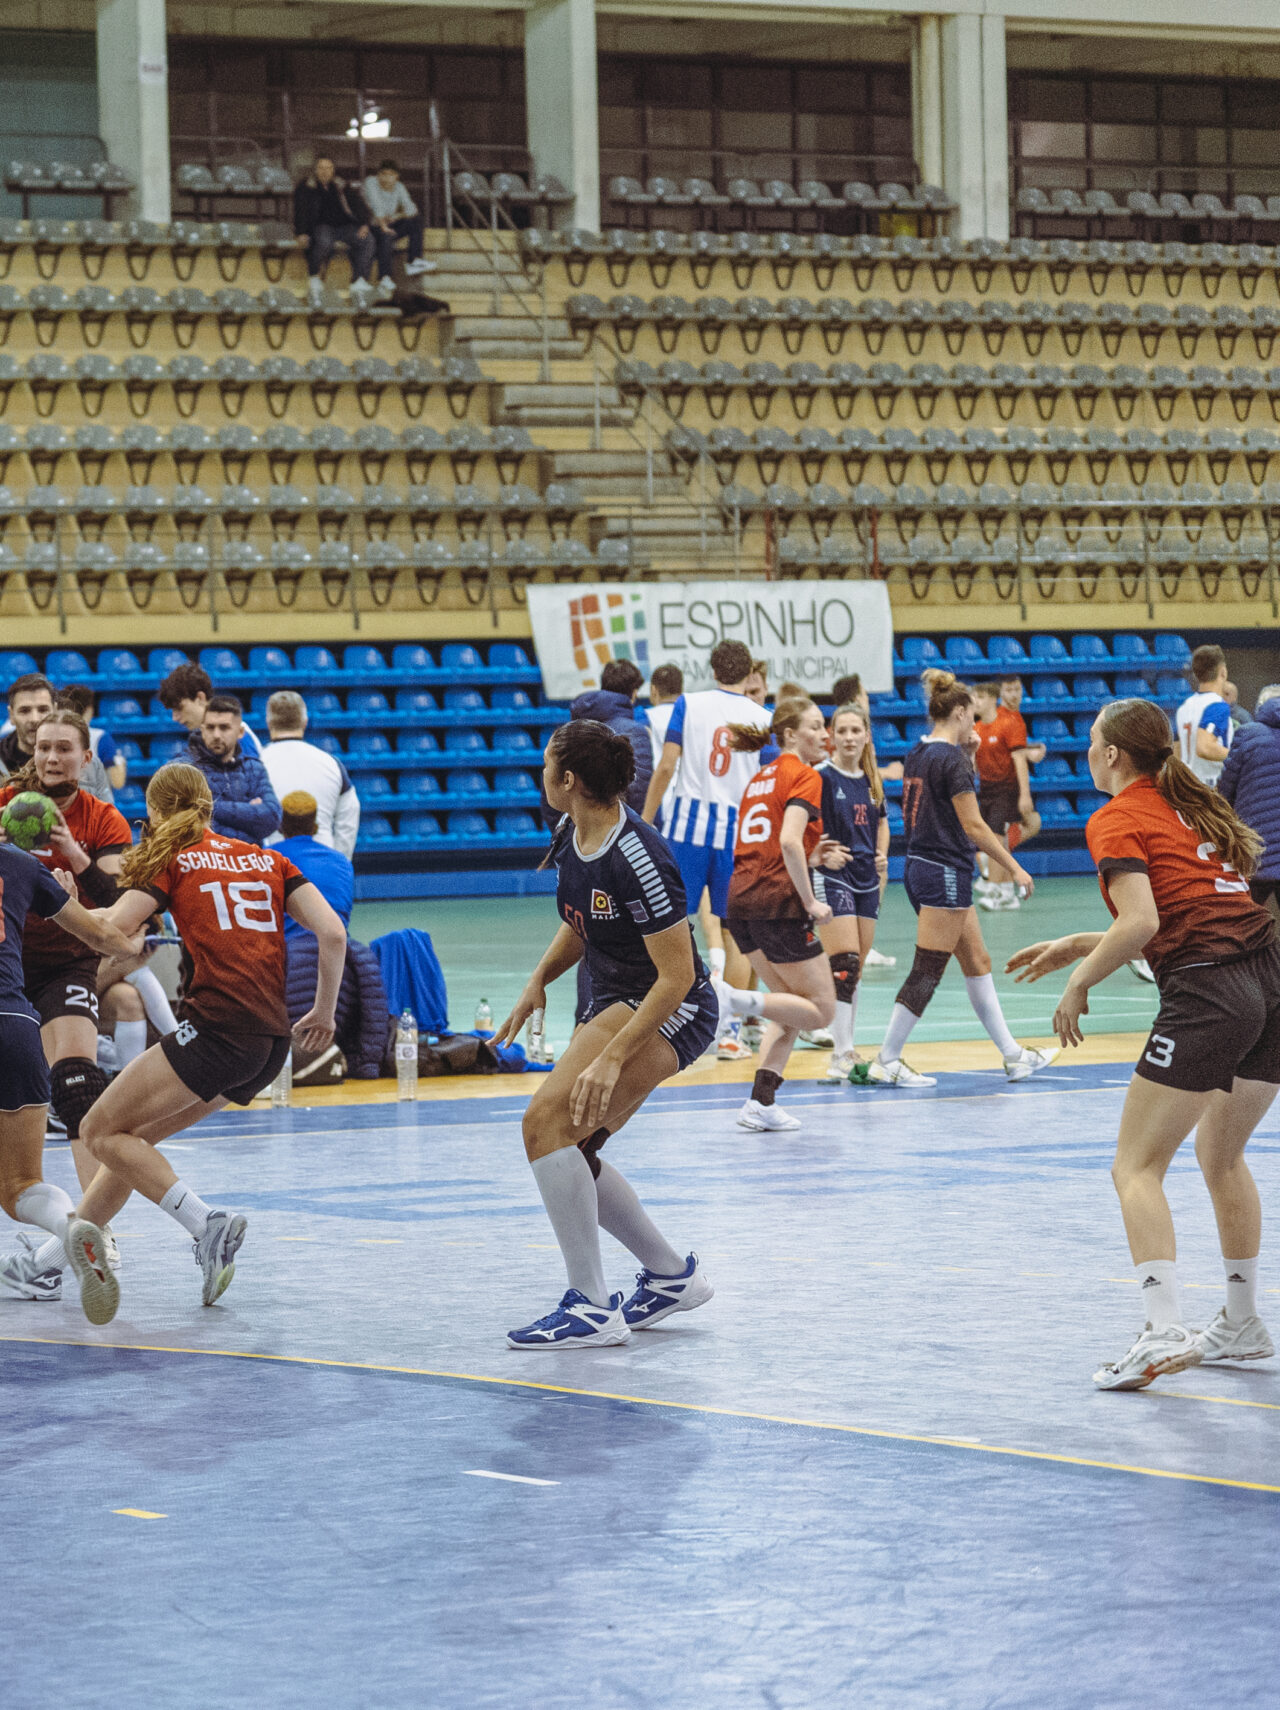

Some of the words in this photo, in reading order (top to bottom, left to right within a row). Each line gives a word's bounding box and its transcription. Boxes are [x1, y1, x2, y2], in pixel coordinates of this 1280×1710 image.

[659, 598, 855, 650] ESPINHO
[708, 726, 735, 778] 8
[740, 803, 772, 844] 6
[176, 851, 275, 873] SCHJELLERUP
[199, 880, 278, 933] 18
[64, 984, 99, 1020] 22
[1145, 1034, 1176, 1068] 3
